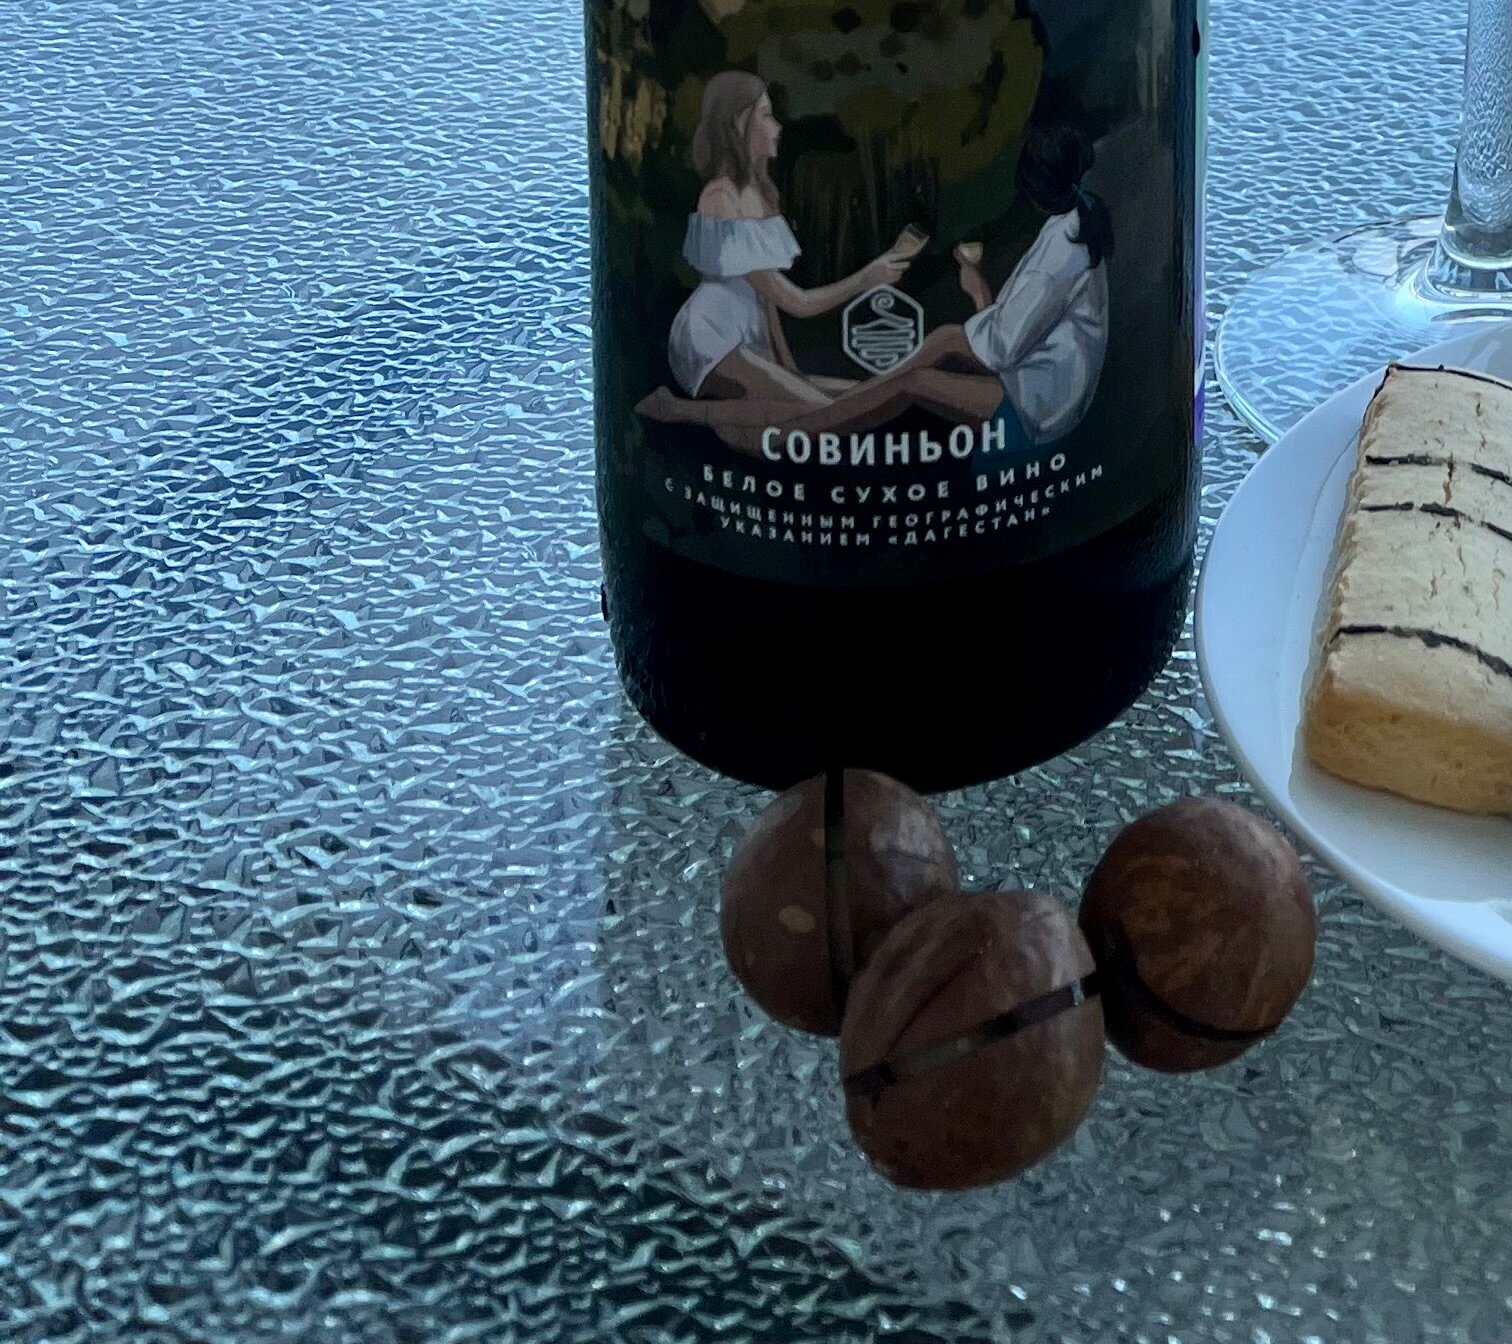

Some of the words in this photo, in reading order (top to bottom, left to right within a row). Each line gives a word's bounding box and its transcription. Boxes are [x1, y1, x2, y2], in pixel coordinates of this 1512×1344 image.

[761, 417, 1007, 466] СОВИНЬОН
[664, 477, 675, 493] С
[684, 485, 855, 530] ЗАЩИЩЕННЫМ
[872, 464, 1104, 530] ГЕОГРАФИЧЕСКИМ
[702, 463, 806, 502] БЕЛОЕ
[830, 479, 950, 505] СУХОЕ
[976, 452, 1067, 492] ВИНО
[719, 516, 871, 547] УКАЗАНИЕМ
